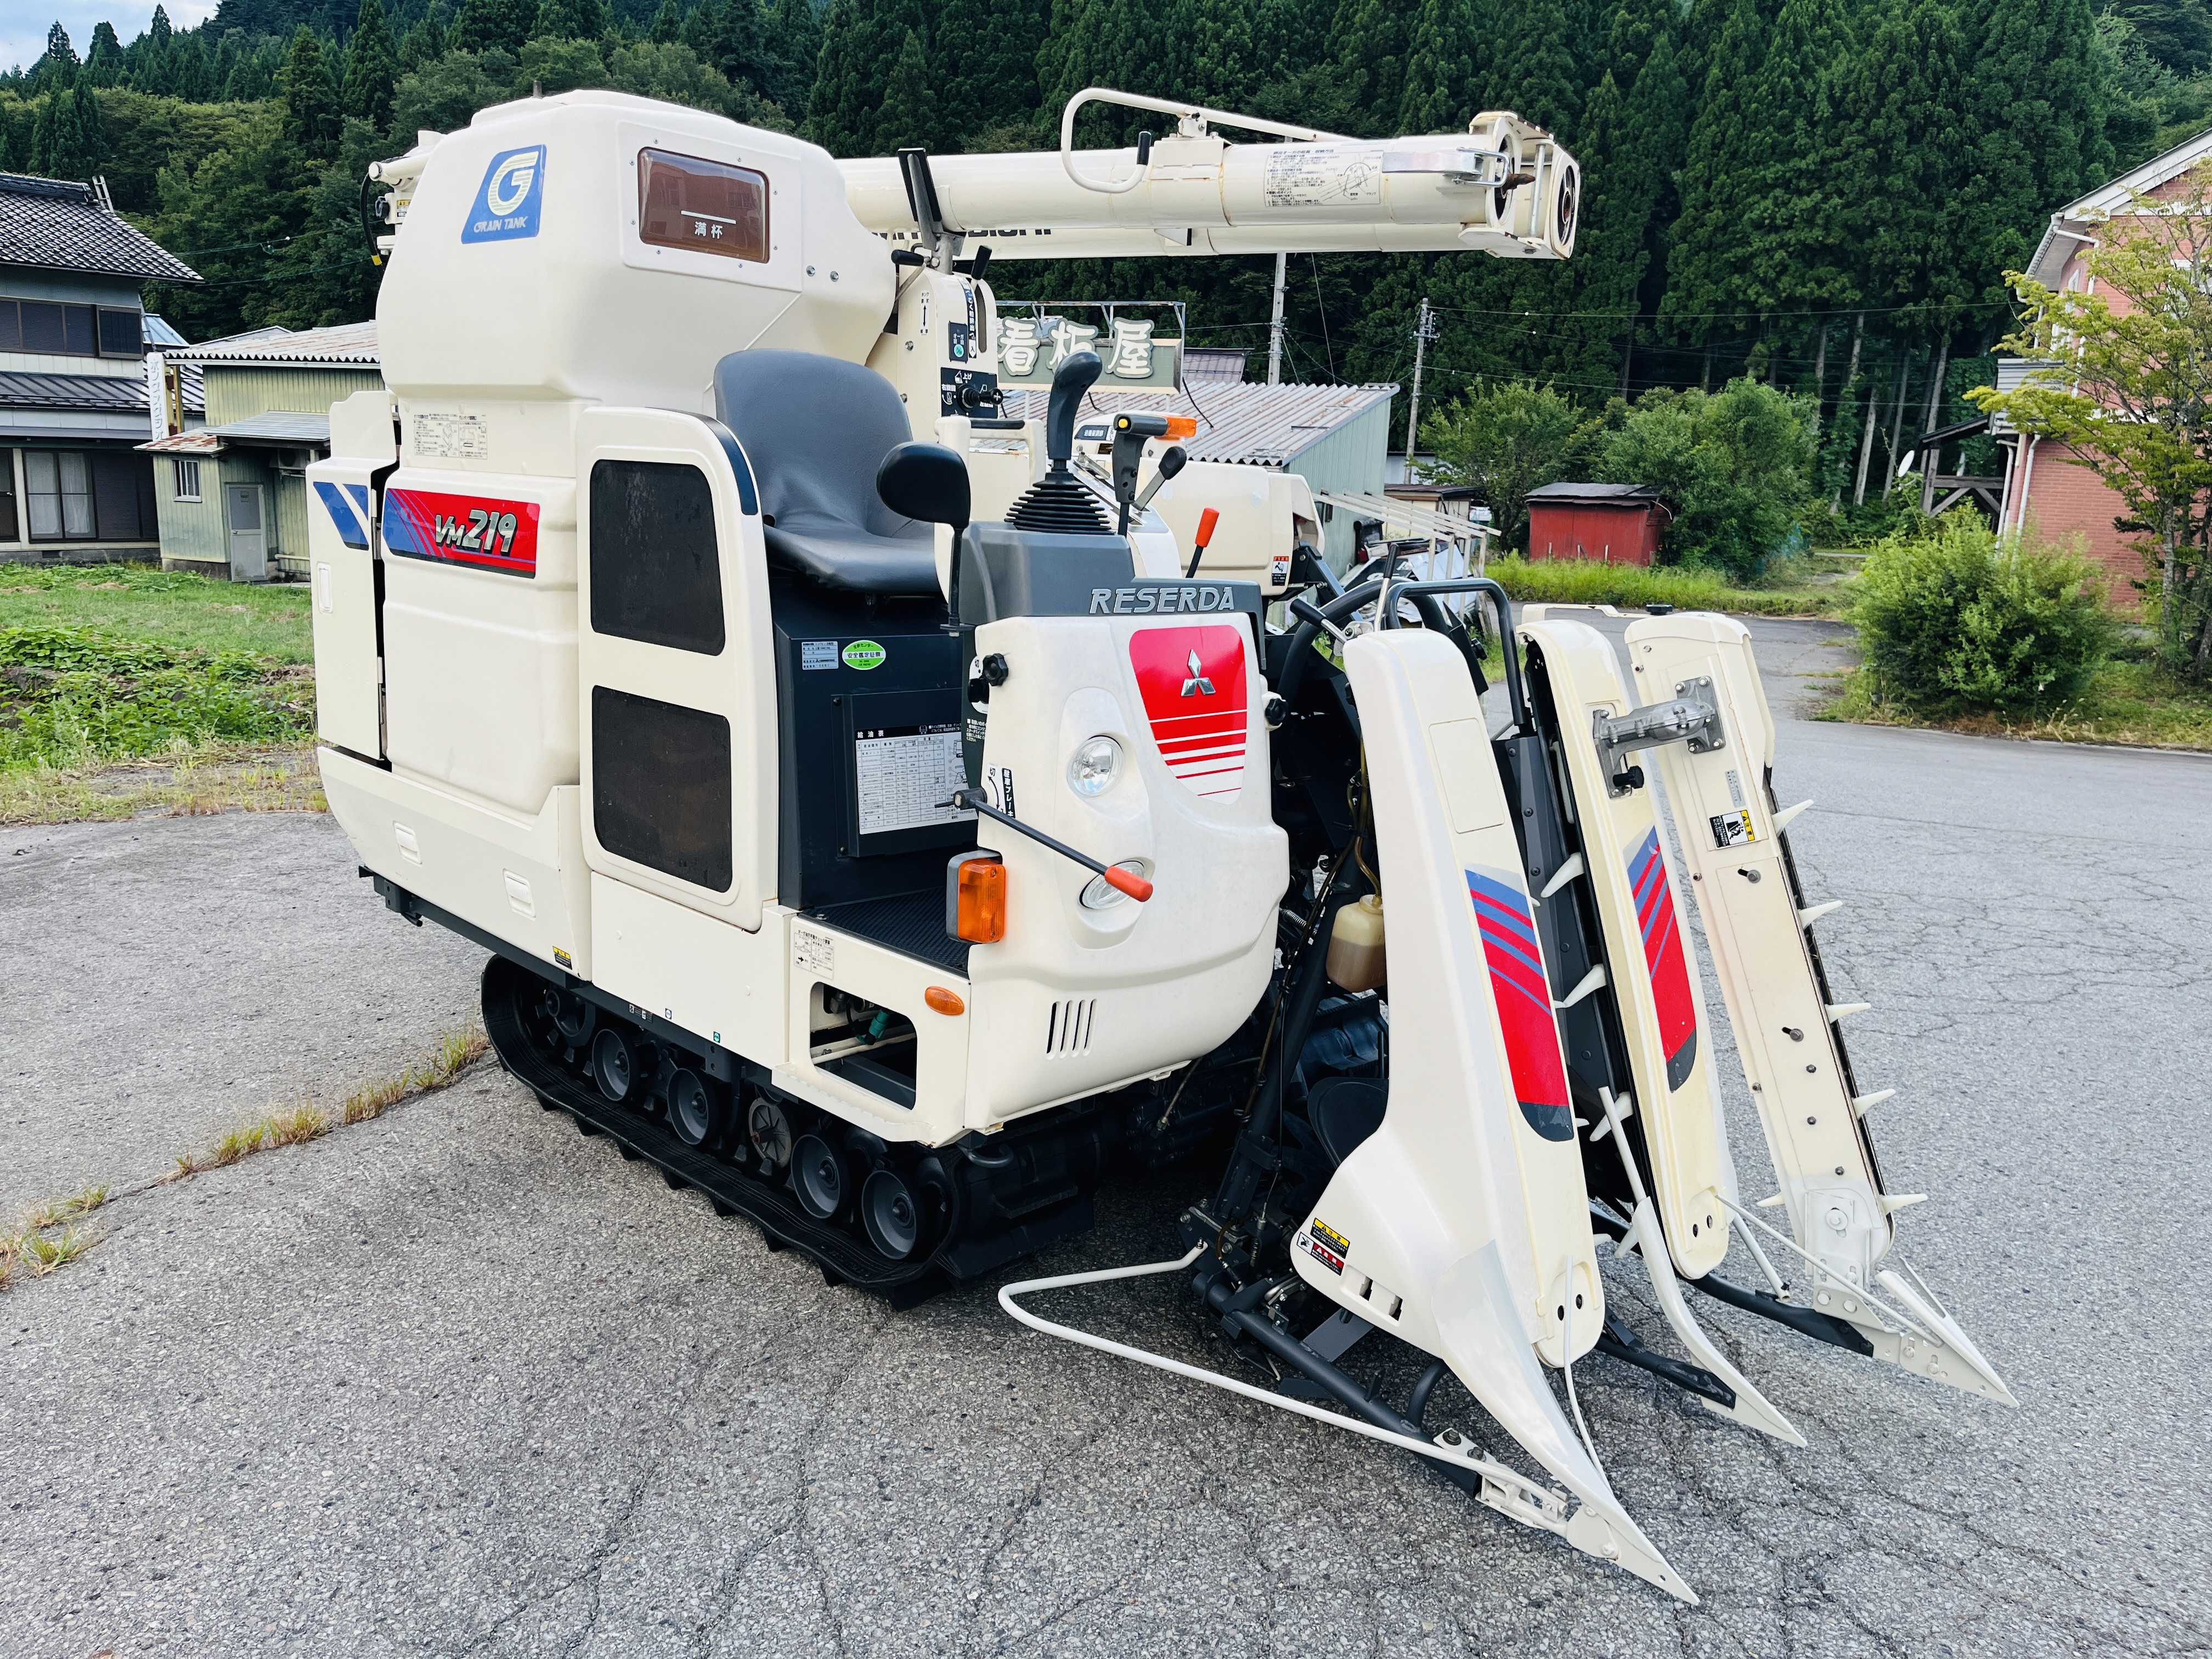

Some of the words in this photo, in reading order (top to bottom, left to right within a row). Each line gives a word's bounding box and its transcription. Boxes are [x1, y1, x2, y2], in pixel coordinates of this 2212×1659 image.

[487, 151, 539, 216] G
[473, 219, 503, 233] GRAIN
[504, 216, 528, 230] TANK
[694, 221, 723, 239] 満杯
[1089, 586, 1234, 614] RESERDA
[990, 767, 996, 777] 切
